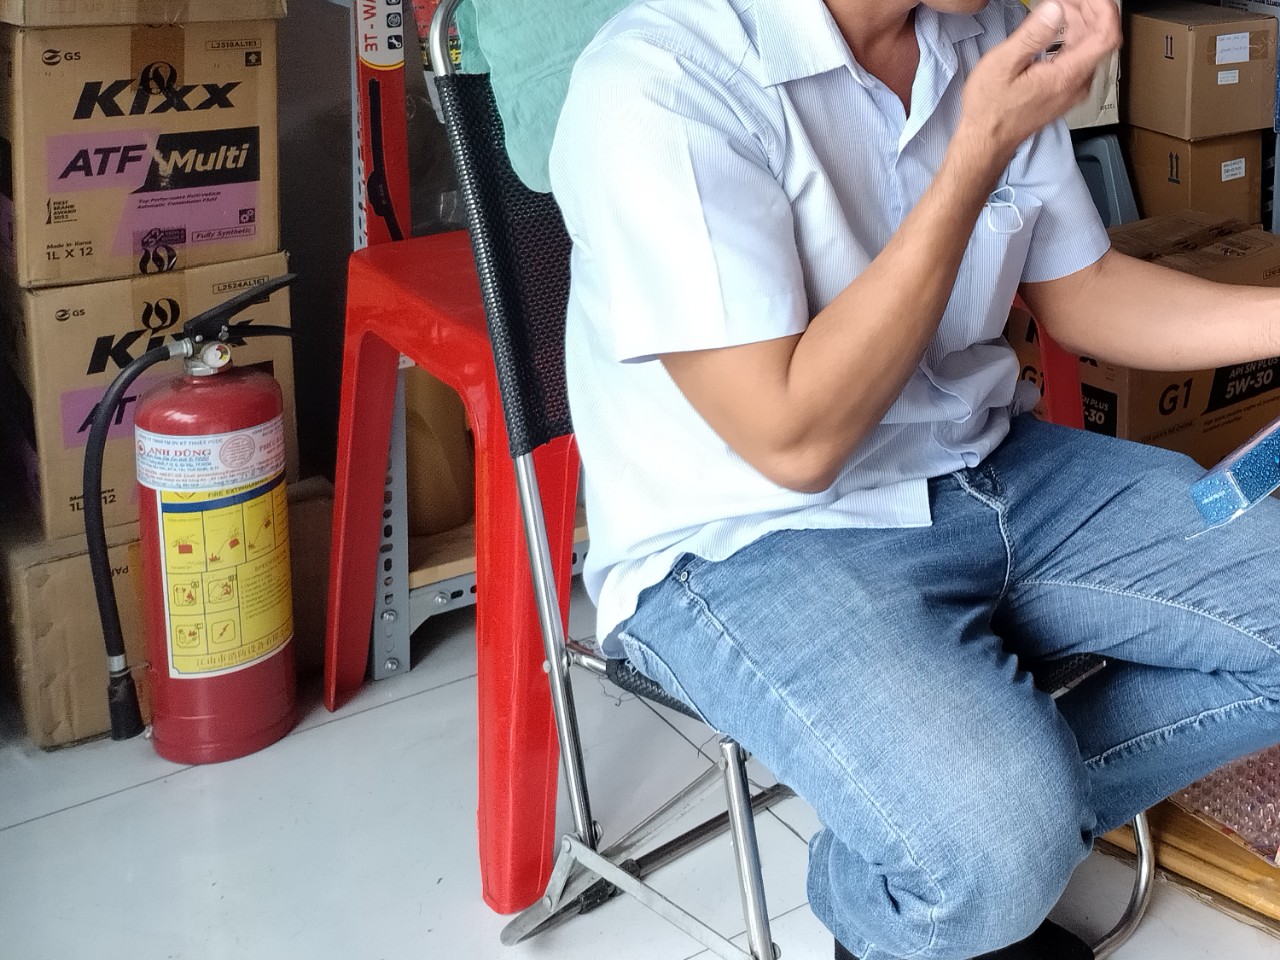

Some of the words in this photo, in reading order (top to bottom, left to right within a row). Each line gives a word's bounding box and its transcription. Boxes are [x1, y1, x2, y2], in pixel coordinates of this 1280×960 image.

[64, 51, 81, 61] GS
[73, 78, 242, 120] Kixx
[58, 143, 147, 179] ATF
[169, 143, 249, 174] Multi
[196, 230, 215, 240] Fully
[217, 227, 252, 237] Synthetic
[80, 247, 93, 257] 12
[72, 309, 85, 317] GS
[1228, 366, 1243, 379] API
[1244, 361, 1257, 374] SN
[1257, 356, 1280, 370] PLUS
[1224, 369, 1273, 399] 5W-30
[1158, 377, 1194, 416] G1
[1090, 398, 1109, 411] PLUS
[148, 447, 170, 456] ANH
